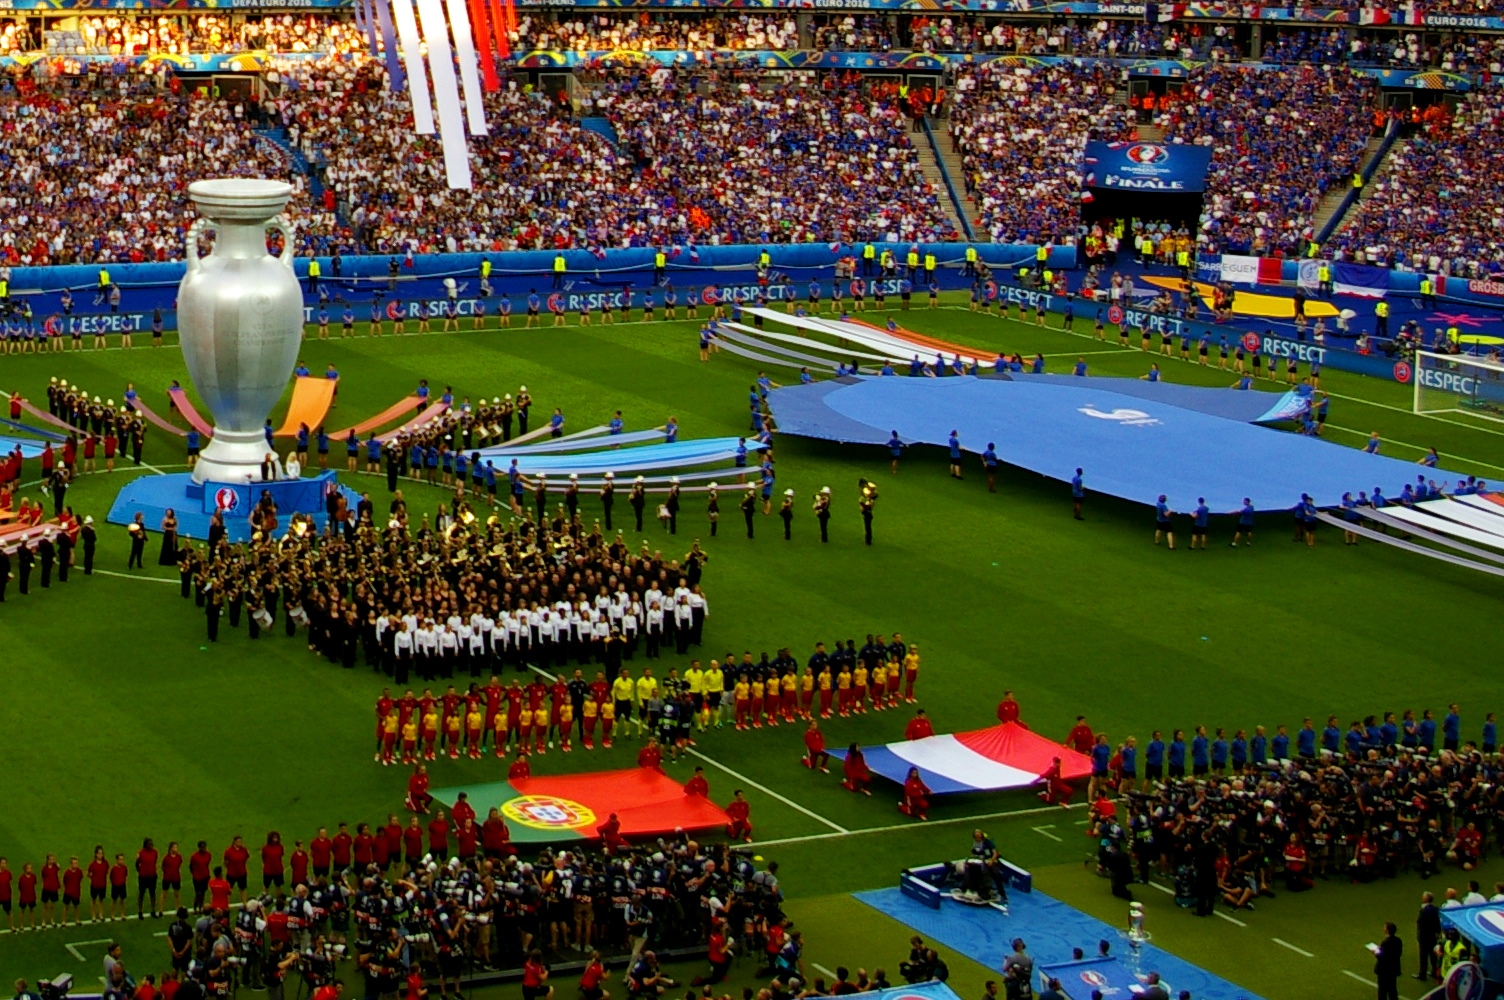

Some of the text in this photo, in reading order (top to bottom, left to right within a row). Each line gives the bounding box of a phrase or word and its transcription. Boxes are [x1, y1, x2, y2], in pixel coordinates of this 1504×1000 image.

[1097, 3, 1145, 14] SAINT-DE
[1427, 16, 1487, 26] EURO 2016
[409, 299, 478, 317] RSPCT
[1125, 310, 1183, 334] REPET
[1418, 368, 1482, 396] RESPECT
